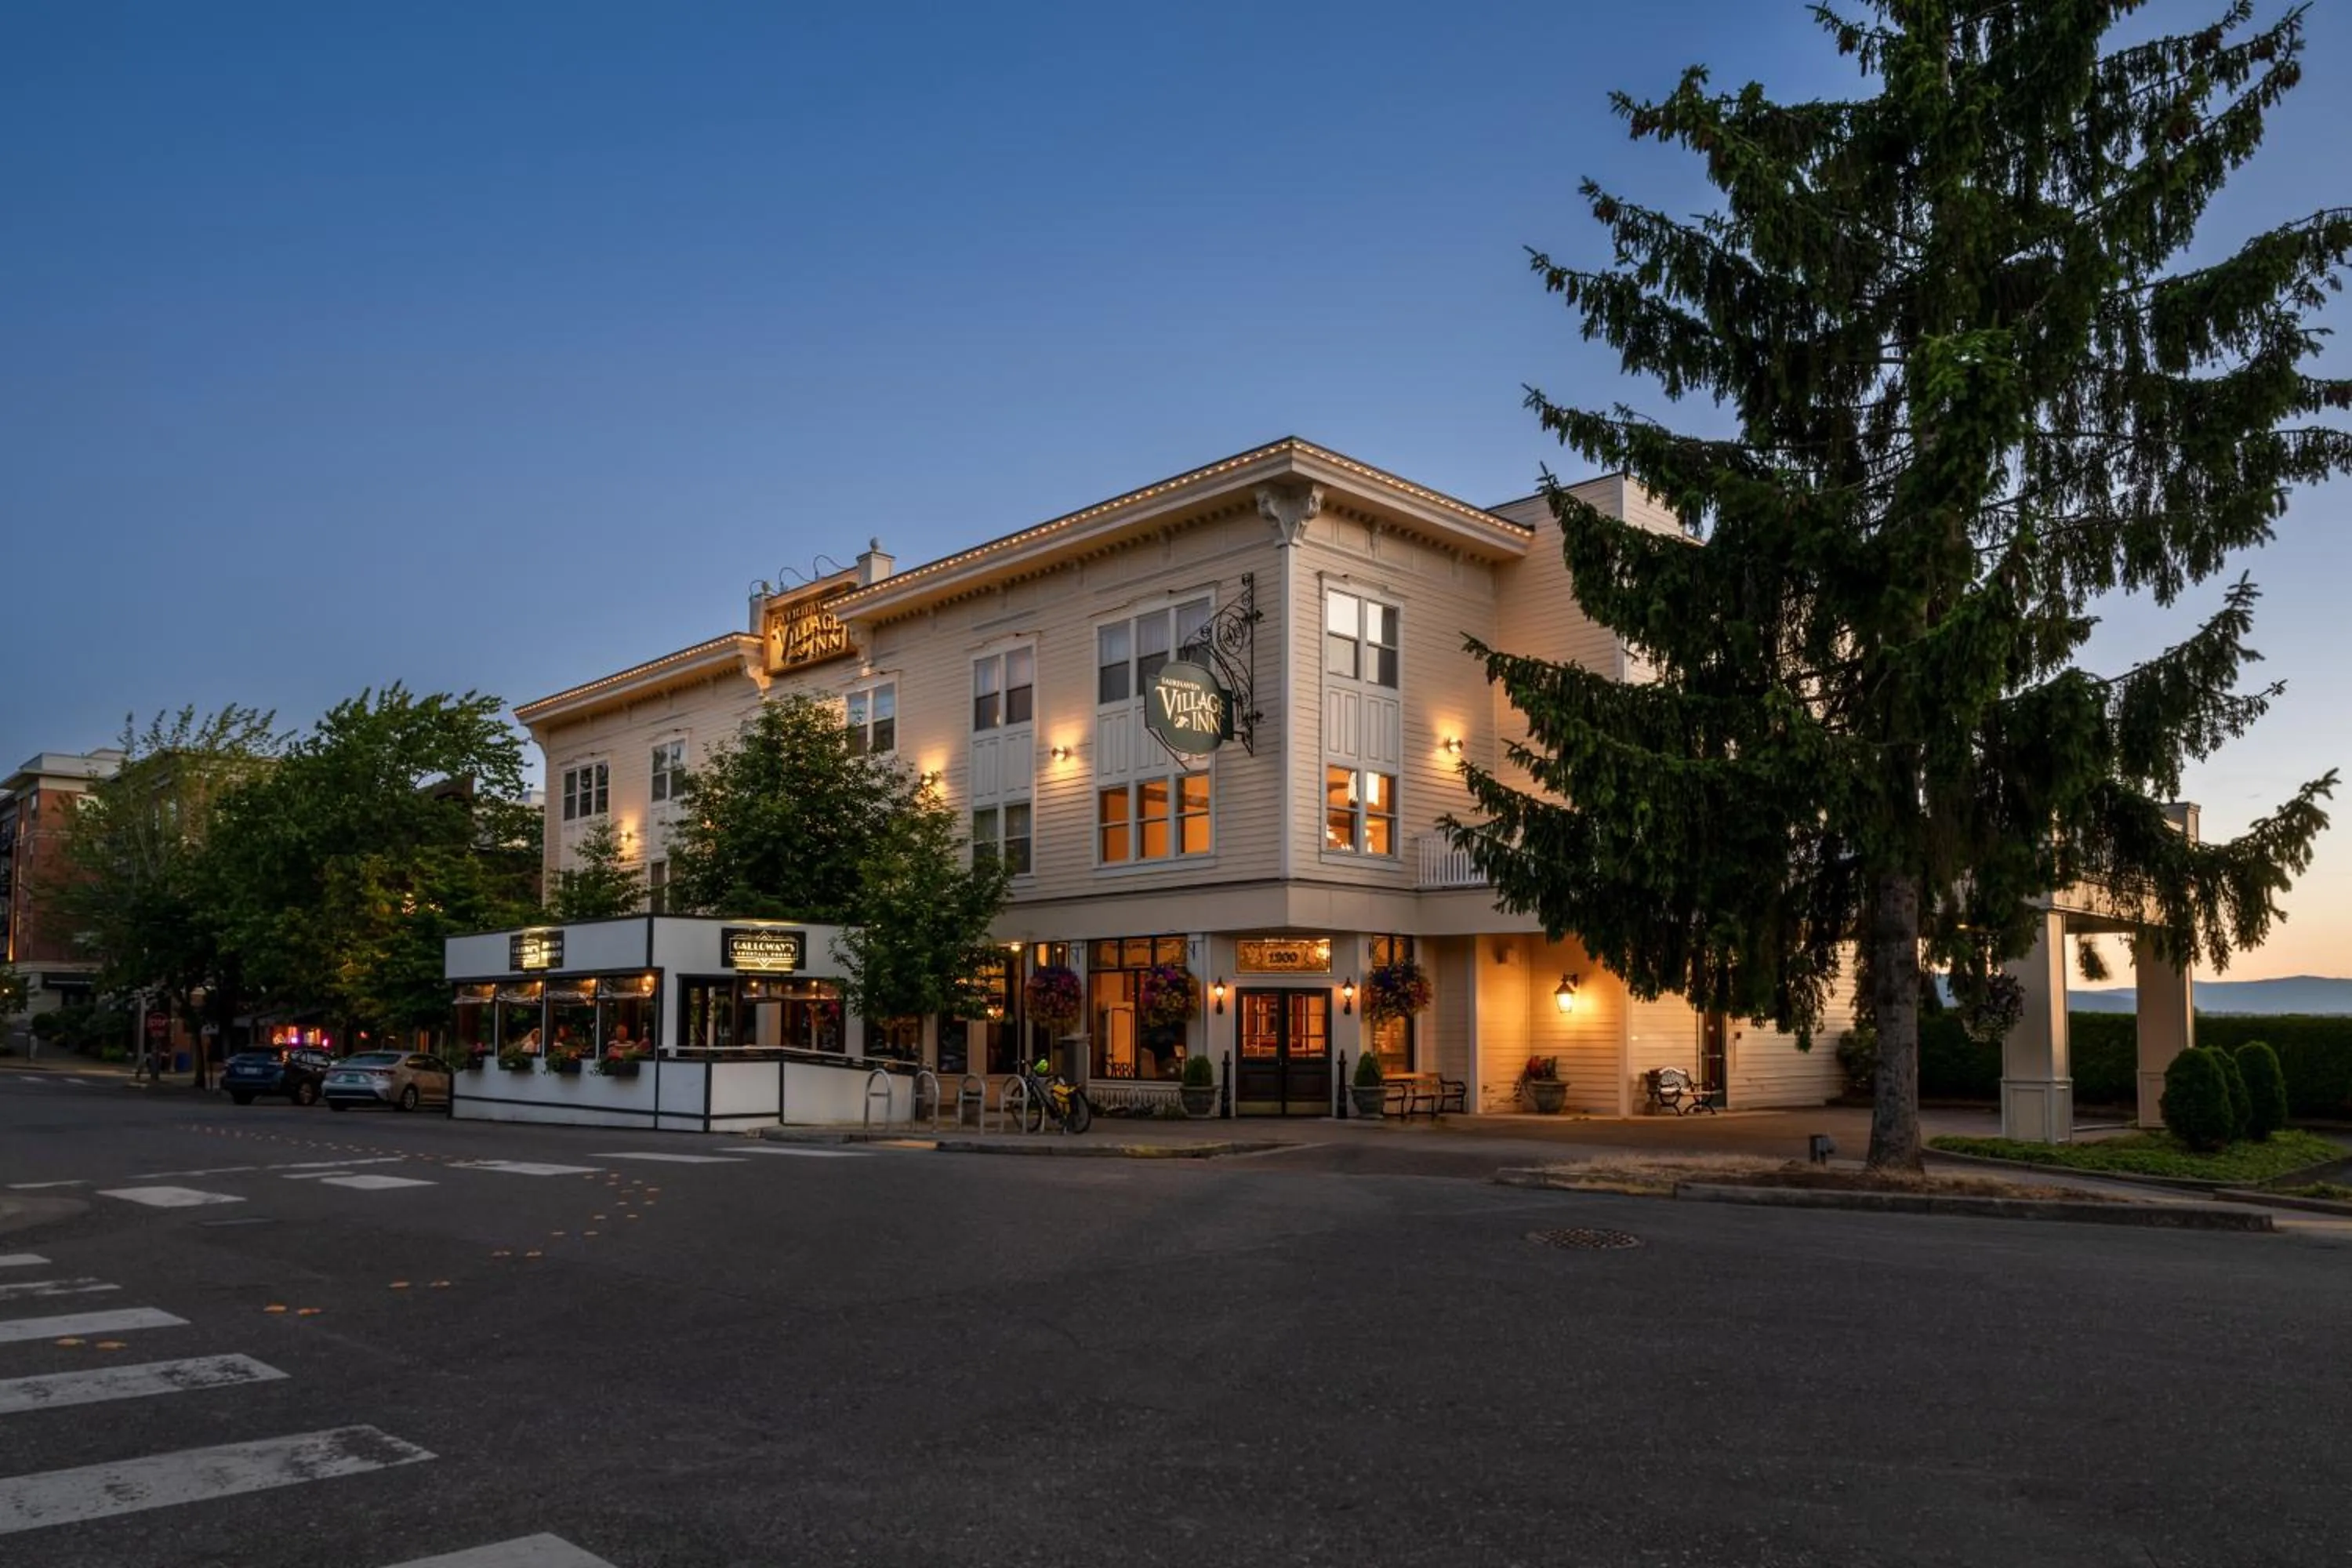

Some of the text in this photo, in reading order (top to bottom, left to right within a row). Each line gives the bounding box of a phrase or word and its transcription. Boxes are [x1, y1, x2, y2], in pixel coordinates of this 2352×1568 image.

[808, 633, 840, 659] INN
[1155, 686, 1225, 720] VILLAGE
[1192, 711, 1221, 734] INN
[733, 941, 796, 953] GALLOWAY'S
